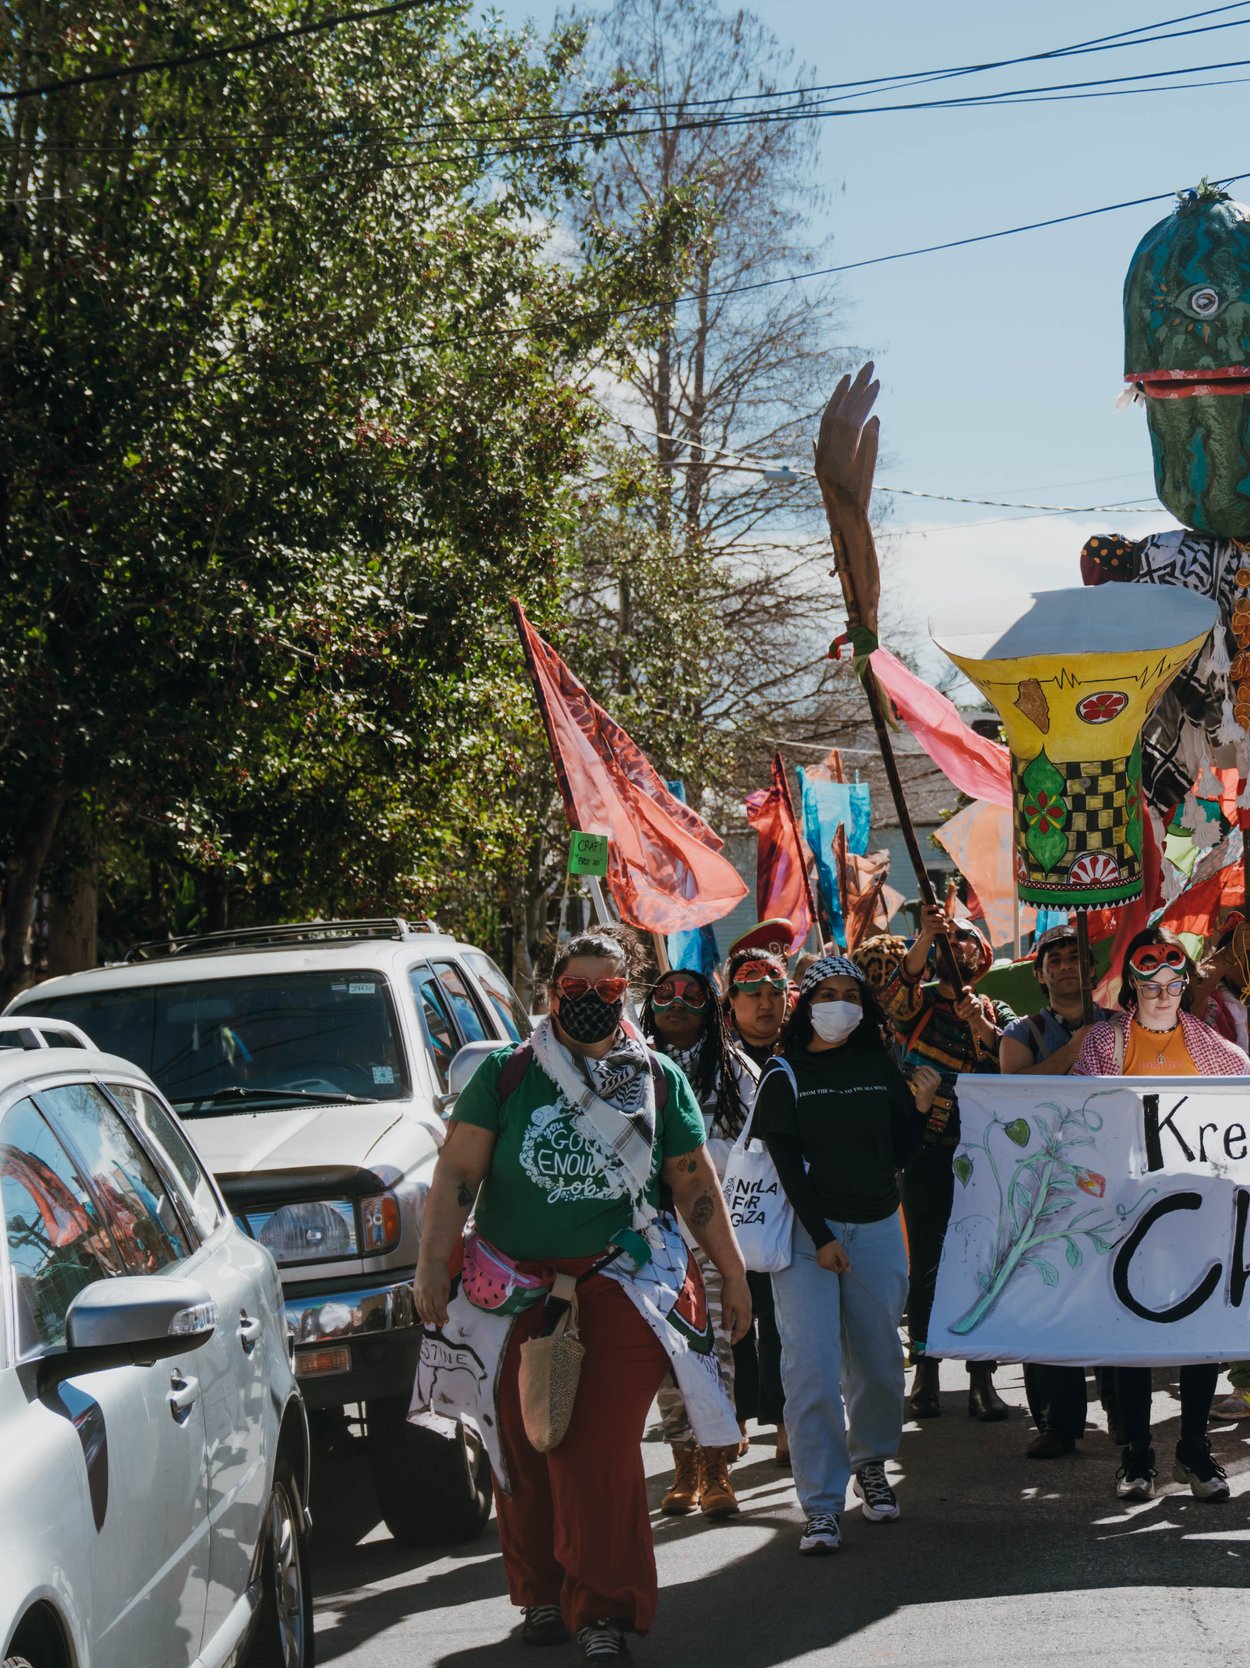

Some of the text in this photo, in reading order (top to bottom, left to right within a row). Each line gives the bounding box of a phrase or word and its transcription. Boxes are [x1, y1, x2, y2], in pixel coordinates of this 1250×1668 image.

[577, 839, 603, 853] CRAFT
[799, 1090, 816, 1098] FROM
[538, 1149, 605, 1178] ENOU
